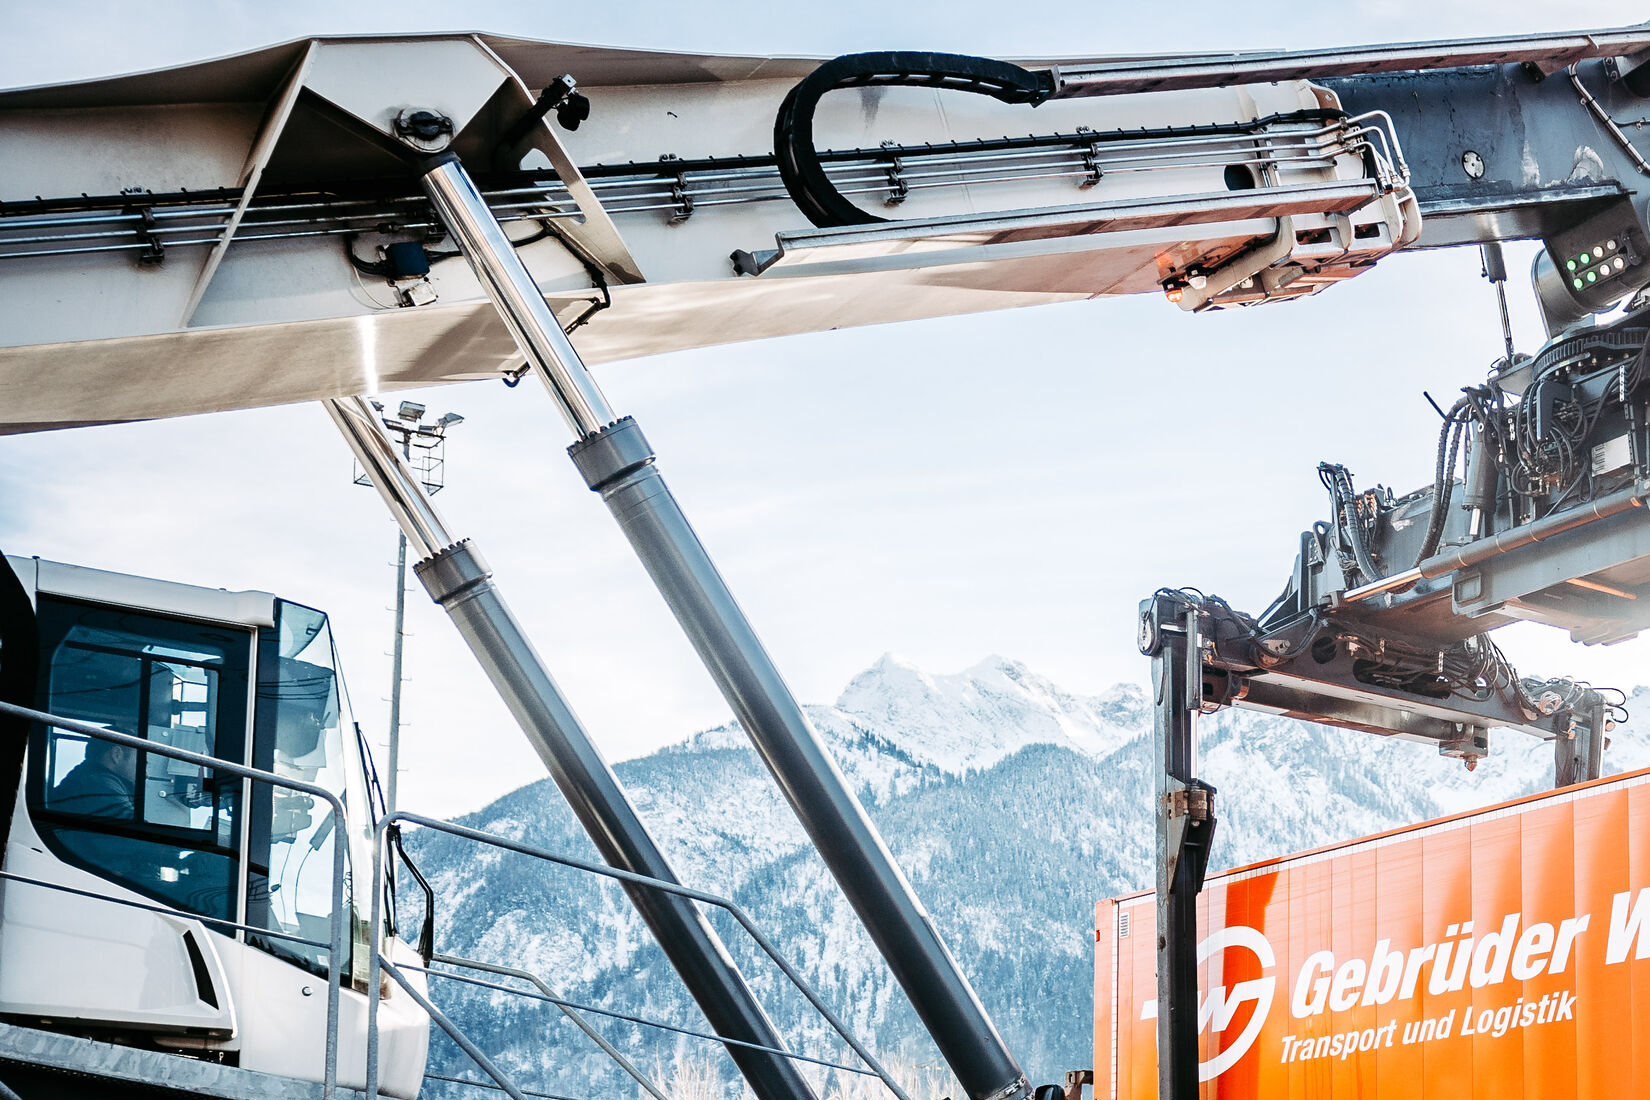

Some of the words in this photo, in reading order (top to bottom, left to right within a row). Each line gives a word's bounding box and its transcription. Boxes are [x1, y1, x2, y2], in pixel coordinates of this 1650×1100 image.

[1291, 912, 1591, 1019] Gebrüder
[1280, 1019, 1398, 1064] Transport
[1402, 1009, 1456, 1045] und
[1460, 990, 1578, 1038] Logistik
